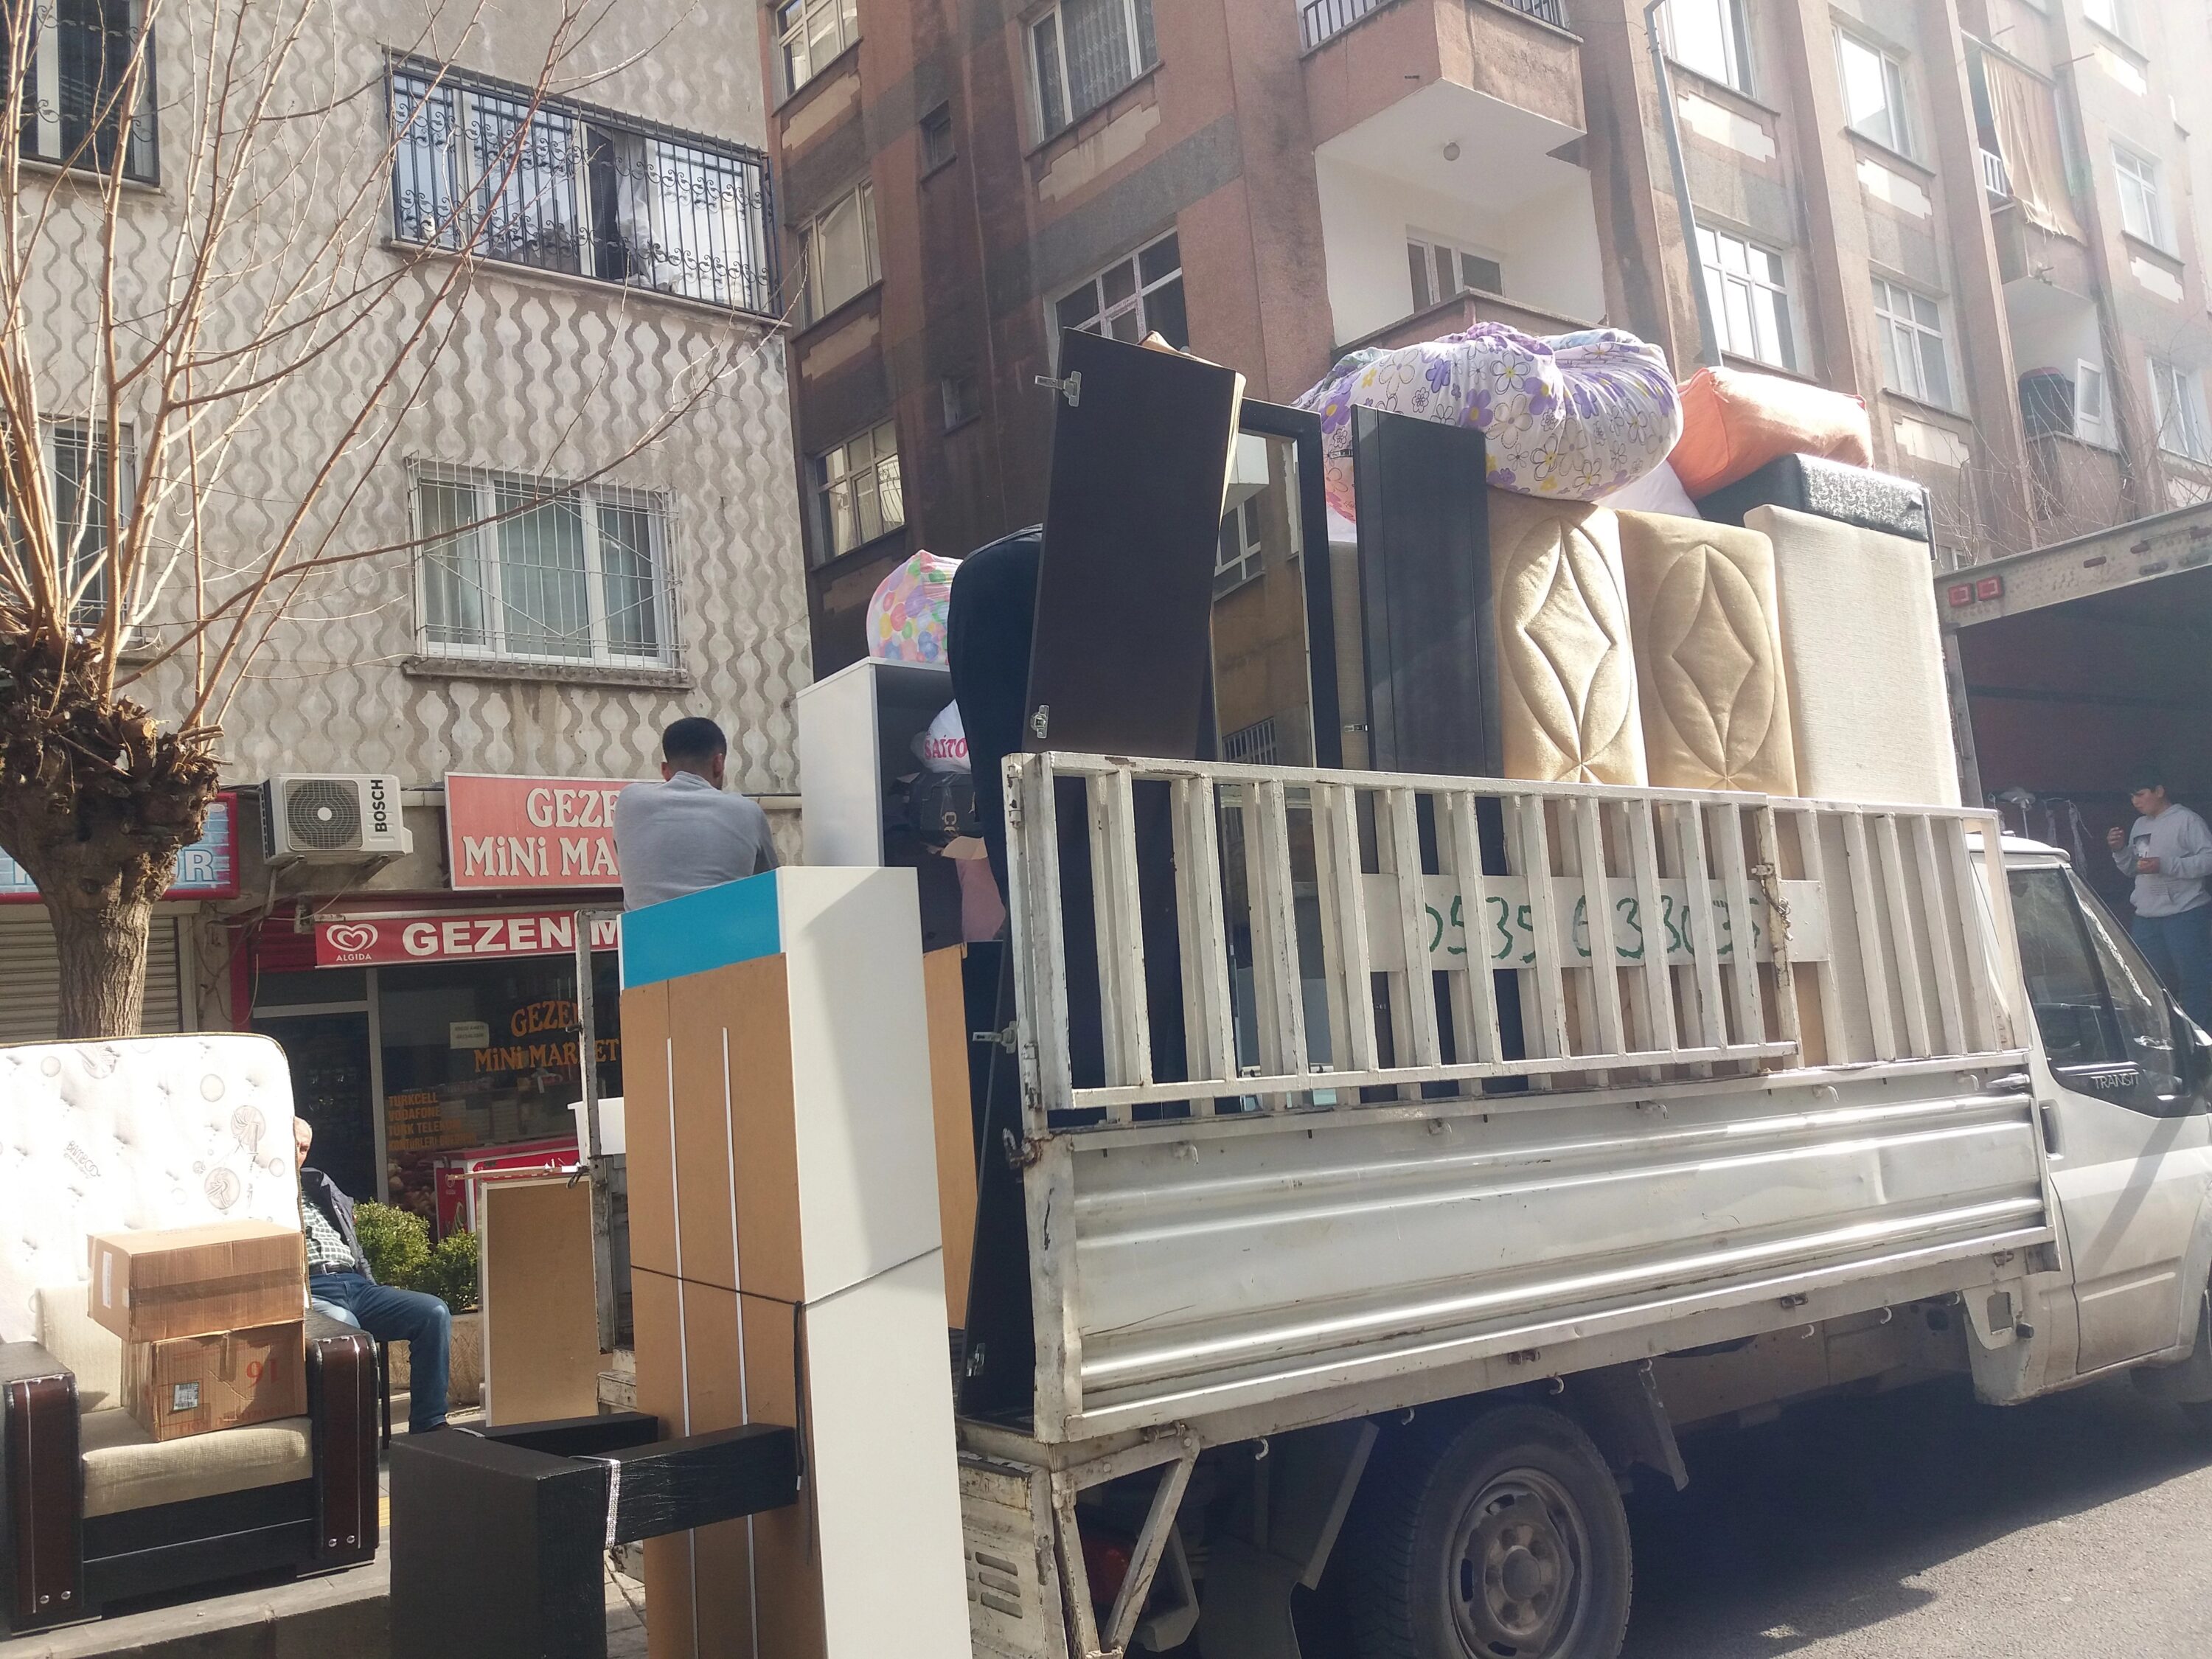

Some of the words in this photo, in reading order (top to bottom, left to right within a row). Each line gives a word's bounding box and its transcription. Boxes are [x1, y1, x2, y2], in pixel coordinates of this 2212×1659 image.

[370, 779, 388, 832] BOSCH
[403, 916, 572, 956] GEZEN
[336, 953, 372, 962] ALGIDA
[529, 1038, 620, 1068] MARET
[2091, 1073, 2139, 1091] TRANSIT
